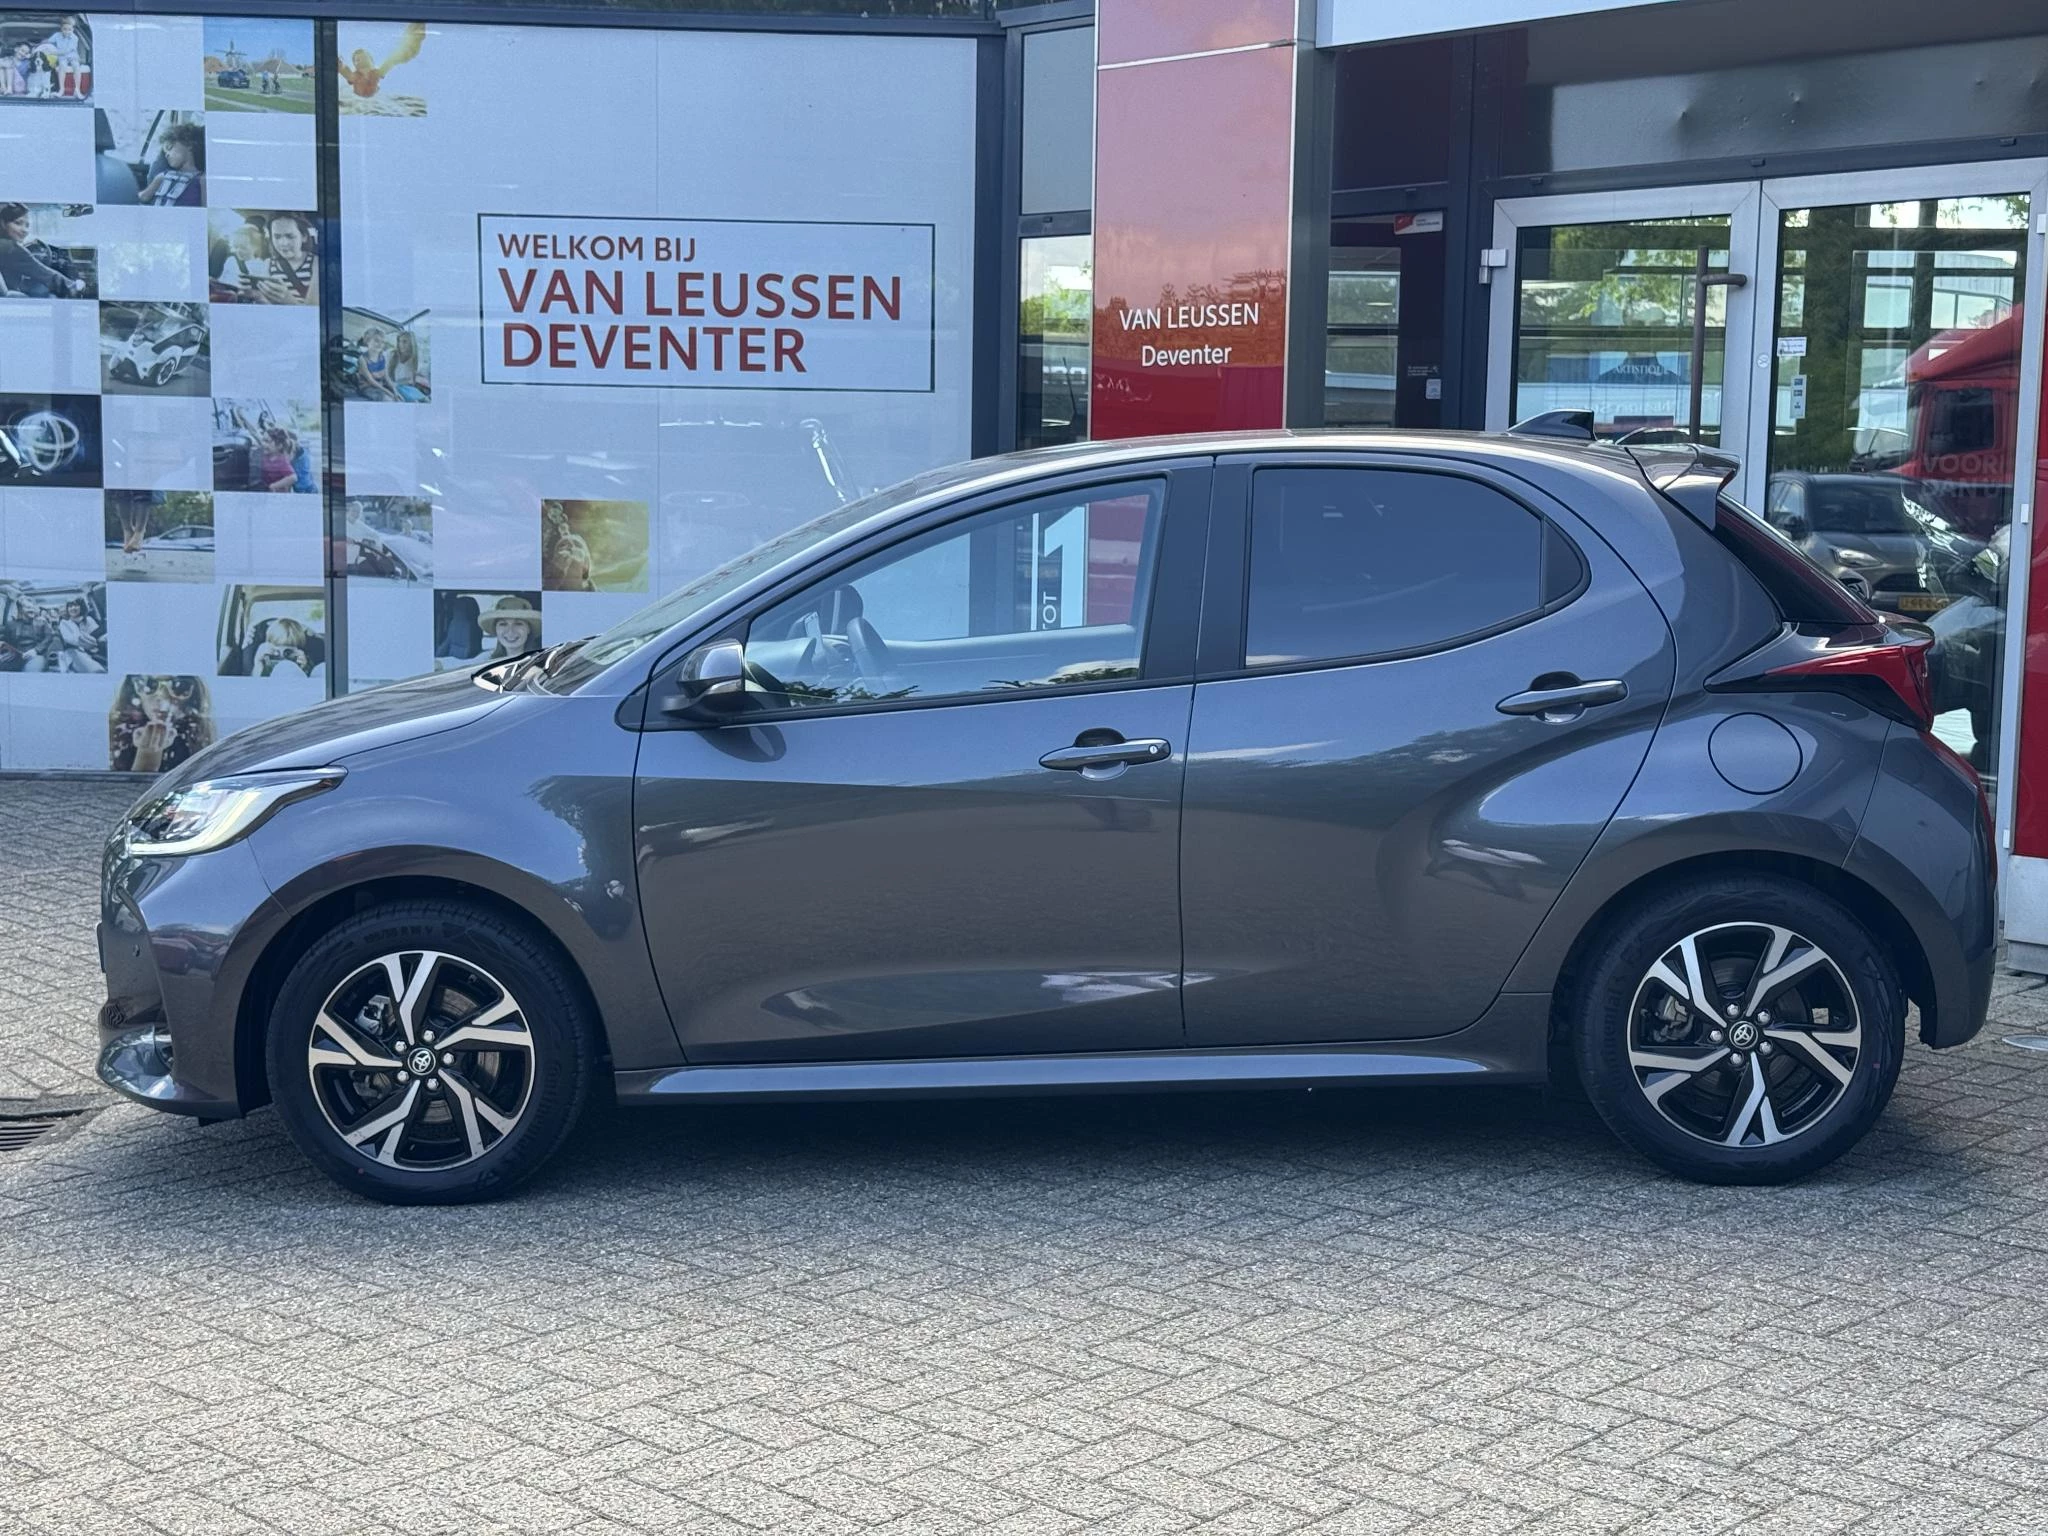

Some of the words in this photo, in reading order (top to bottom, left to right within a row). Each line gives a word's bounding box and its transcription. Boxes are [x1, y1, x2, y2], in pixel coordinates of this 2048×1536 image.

[497, 233, 643, 261] WELKOM
[654, 236, 696, 262] BIJ
[498, 268, 623, 315] VAN
[646, 271, 901, 321] LEUSSEN
[1119, 309, 1162, 331] VAN
[1167, 302, 1259, 329] LEUSSEN
[503, 323, 807, 373] DEVENTER
[1141, 345, 1233, 367] Deventer
